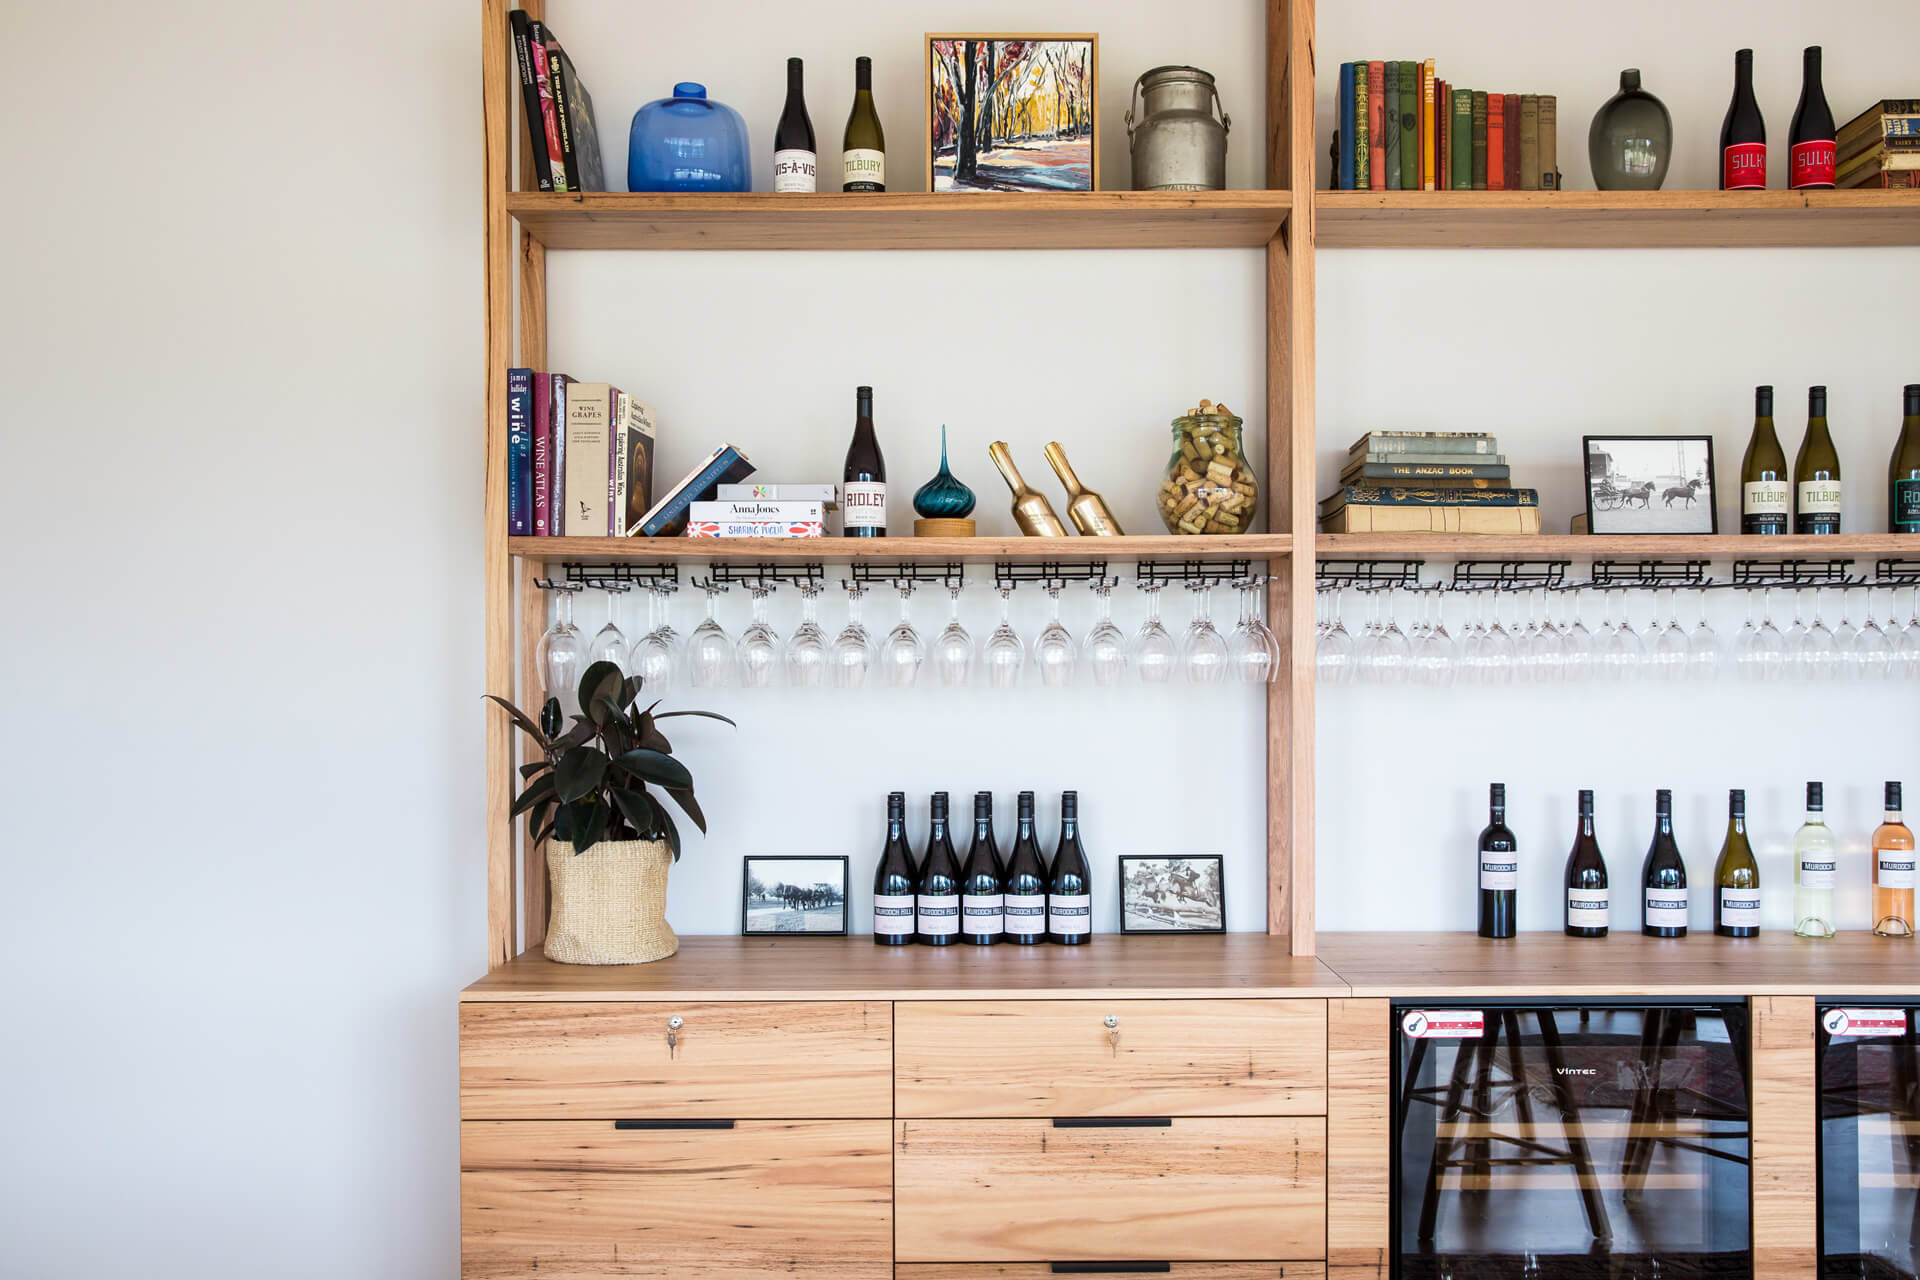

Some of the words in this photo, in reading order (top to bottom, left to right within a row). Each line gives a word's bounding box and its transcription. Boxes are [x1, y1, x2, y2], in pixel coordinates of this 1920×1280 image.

[557, 103, 564, 113] OF
[559, 113, 570, 153] PORCELAIN
[775, 160, 815, 176] VIS-À-VIS
[845, 159, 881, 173] TILBURY
[511, 397, 523, 445] wine
[616, 432, 626, 455] Exploring
[535, 436, 546, 469] WINE
[617, 456, 625, 481] Australian
[1392, 466, 1410, 474] THE
[1415, 466, 1444, 474] ANZAC
[1449, 467, 1474, 475] BOOK
[535, 471, 546, 508] ATLAS
[617, 481, 625, 496] Wines
[847, 492, 885, 507] RIDLEY
[1752, 490, 1786, 503] TILBUR
[730, 503, 755, 513] Anna
[755, 503, 780, 516] Jones
[728, 525, 759, 535] SHARING
[1484, 863, 1511, 872] MURDOCH
[1804, 862, 1832, 871] MURDOCH
[1882, 861, 1911, 871] MURDOCH
[1570, 900, 1598, 909] MURDOCH
[1649, 900, 1677, 909] MURDOCH
[1726, 900, 1753, 909] MURDOCH
